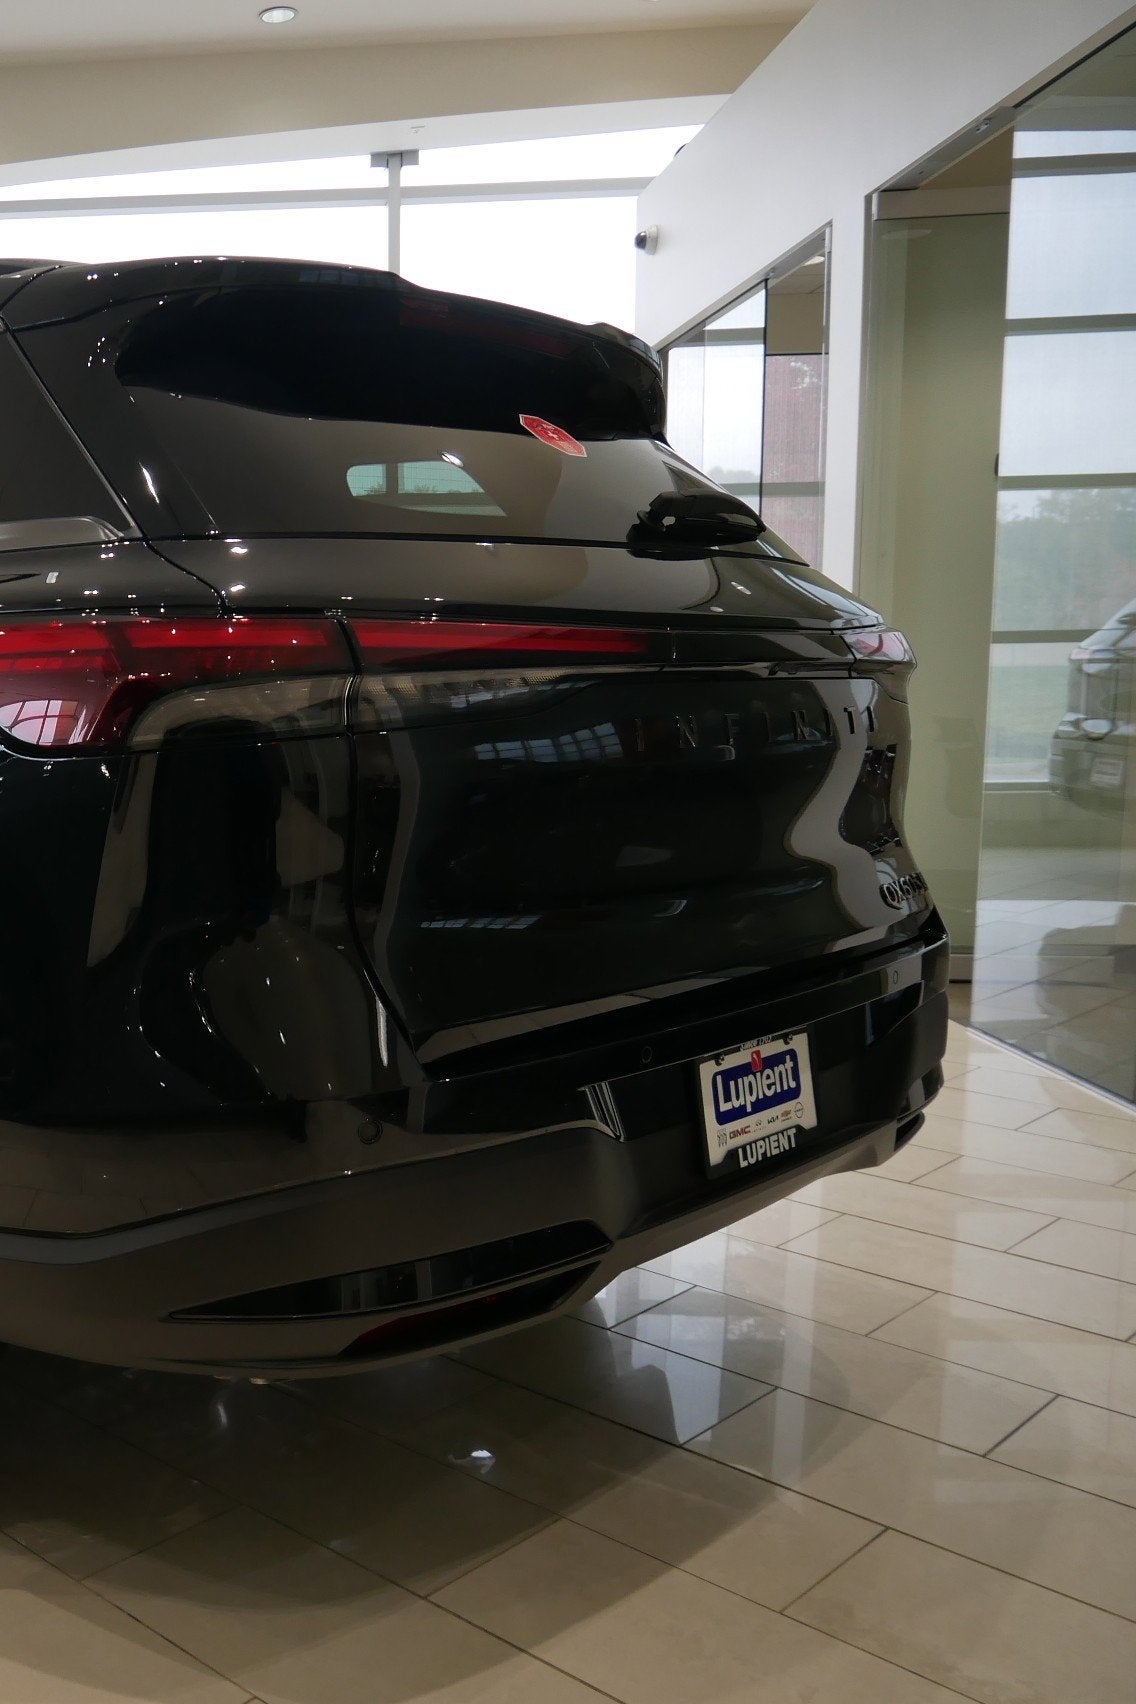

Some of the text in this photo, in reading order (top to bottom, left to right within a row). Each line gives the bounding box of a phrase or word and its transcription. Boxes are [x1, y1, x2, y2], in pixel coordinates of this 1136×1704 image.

[716, 1055, 796, 1112] Lupient
[729, 1125, 751, 1140] GMC
[738, 1127, 797, 1168] LUPIENT
